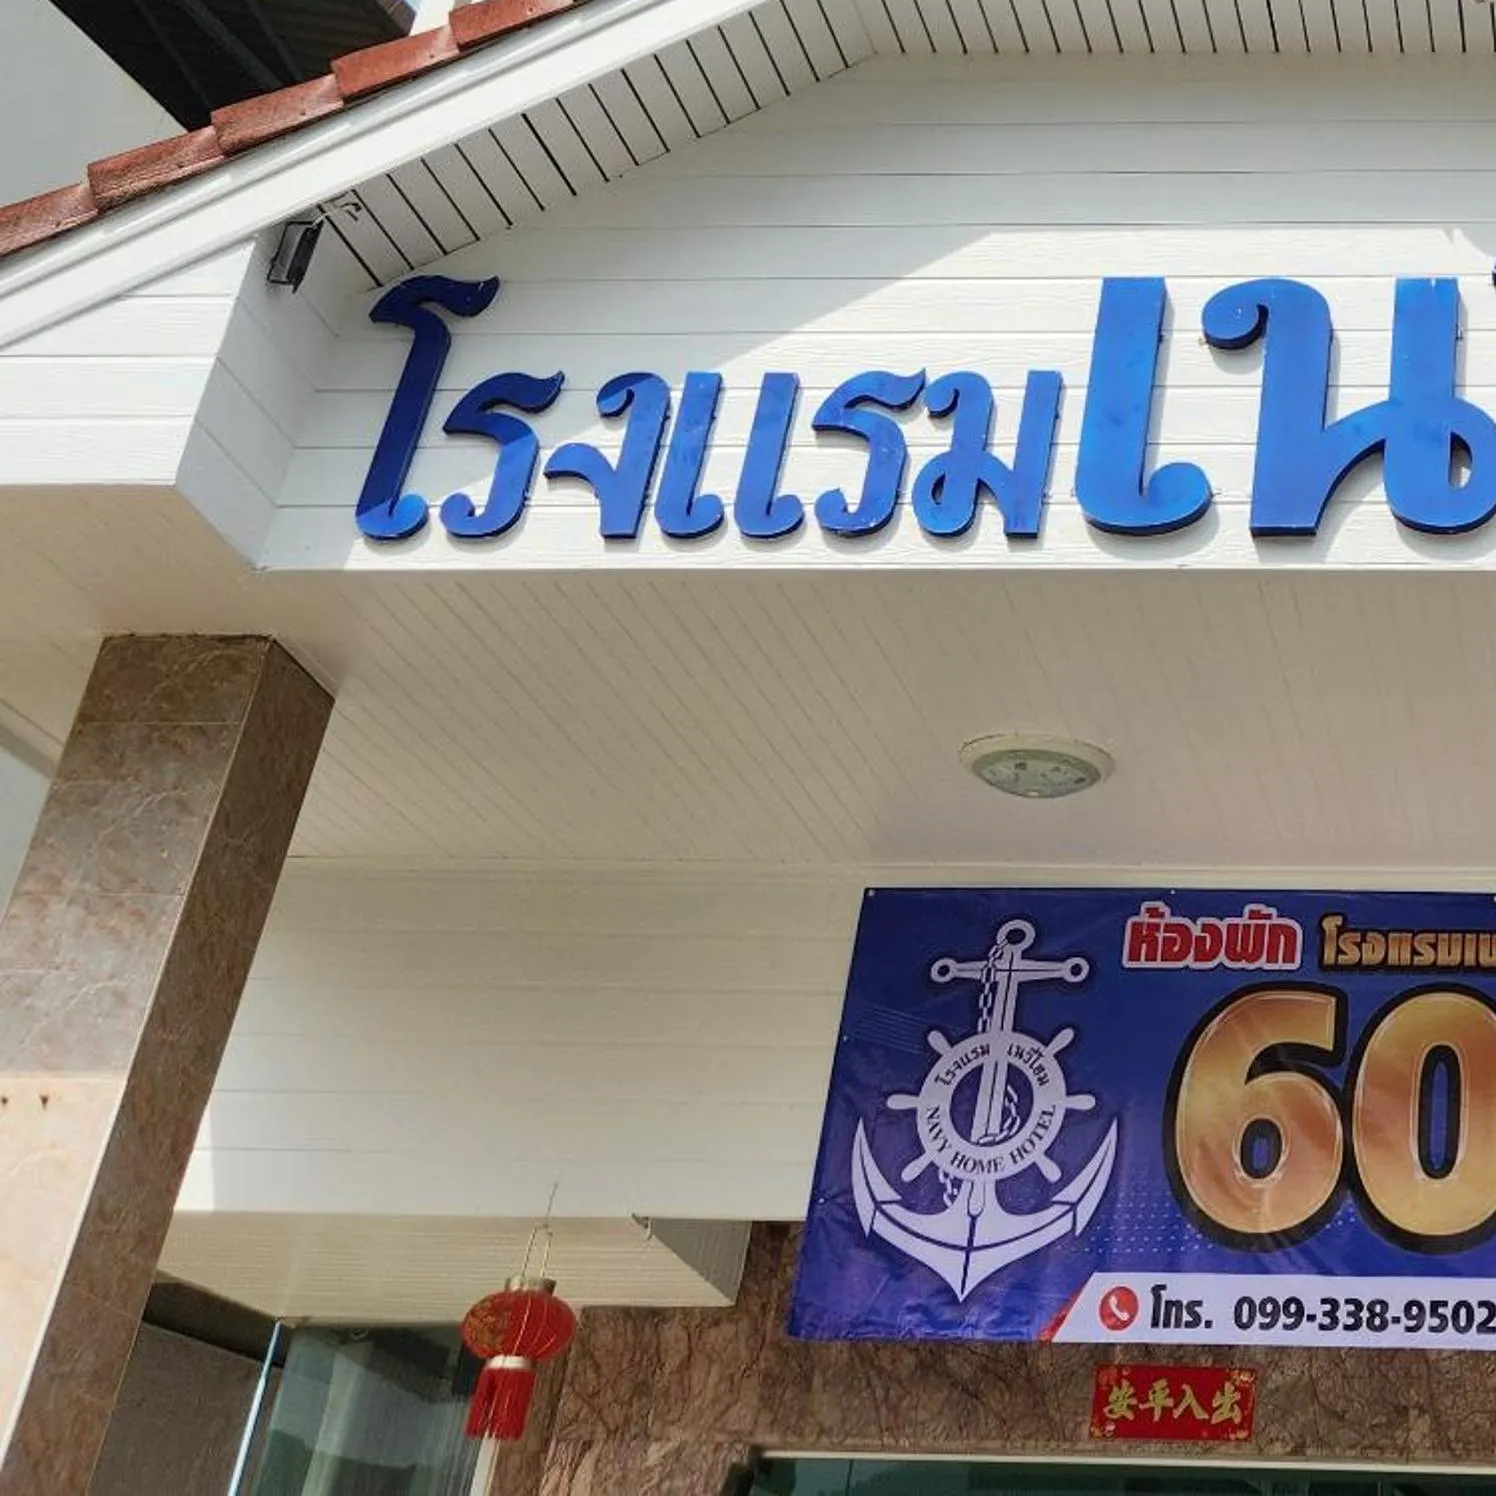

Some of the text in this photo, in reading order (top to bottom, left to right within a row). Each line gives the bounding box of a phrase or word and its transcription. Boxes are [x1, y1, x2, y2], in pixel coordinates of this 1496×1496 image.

[1124, 904, 1299, 967] ห้องพัก
[926, 1104, 1057, 1176] NAVY HOME HOTEL
[1149, 1284, 1213, 1330] โทร.
